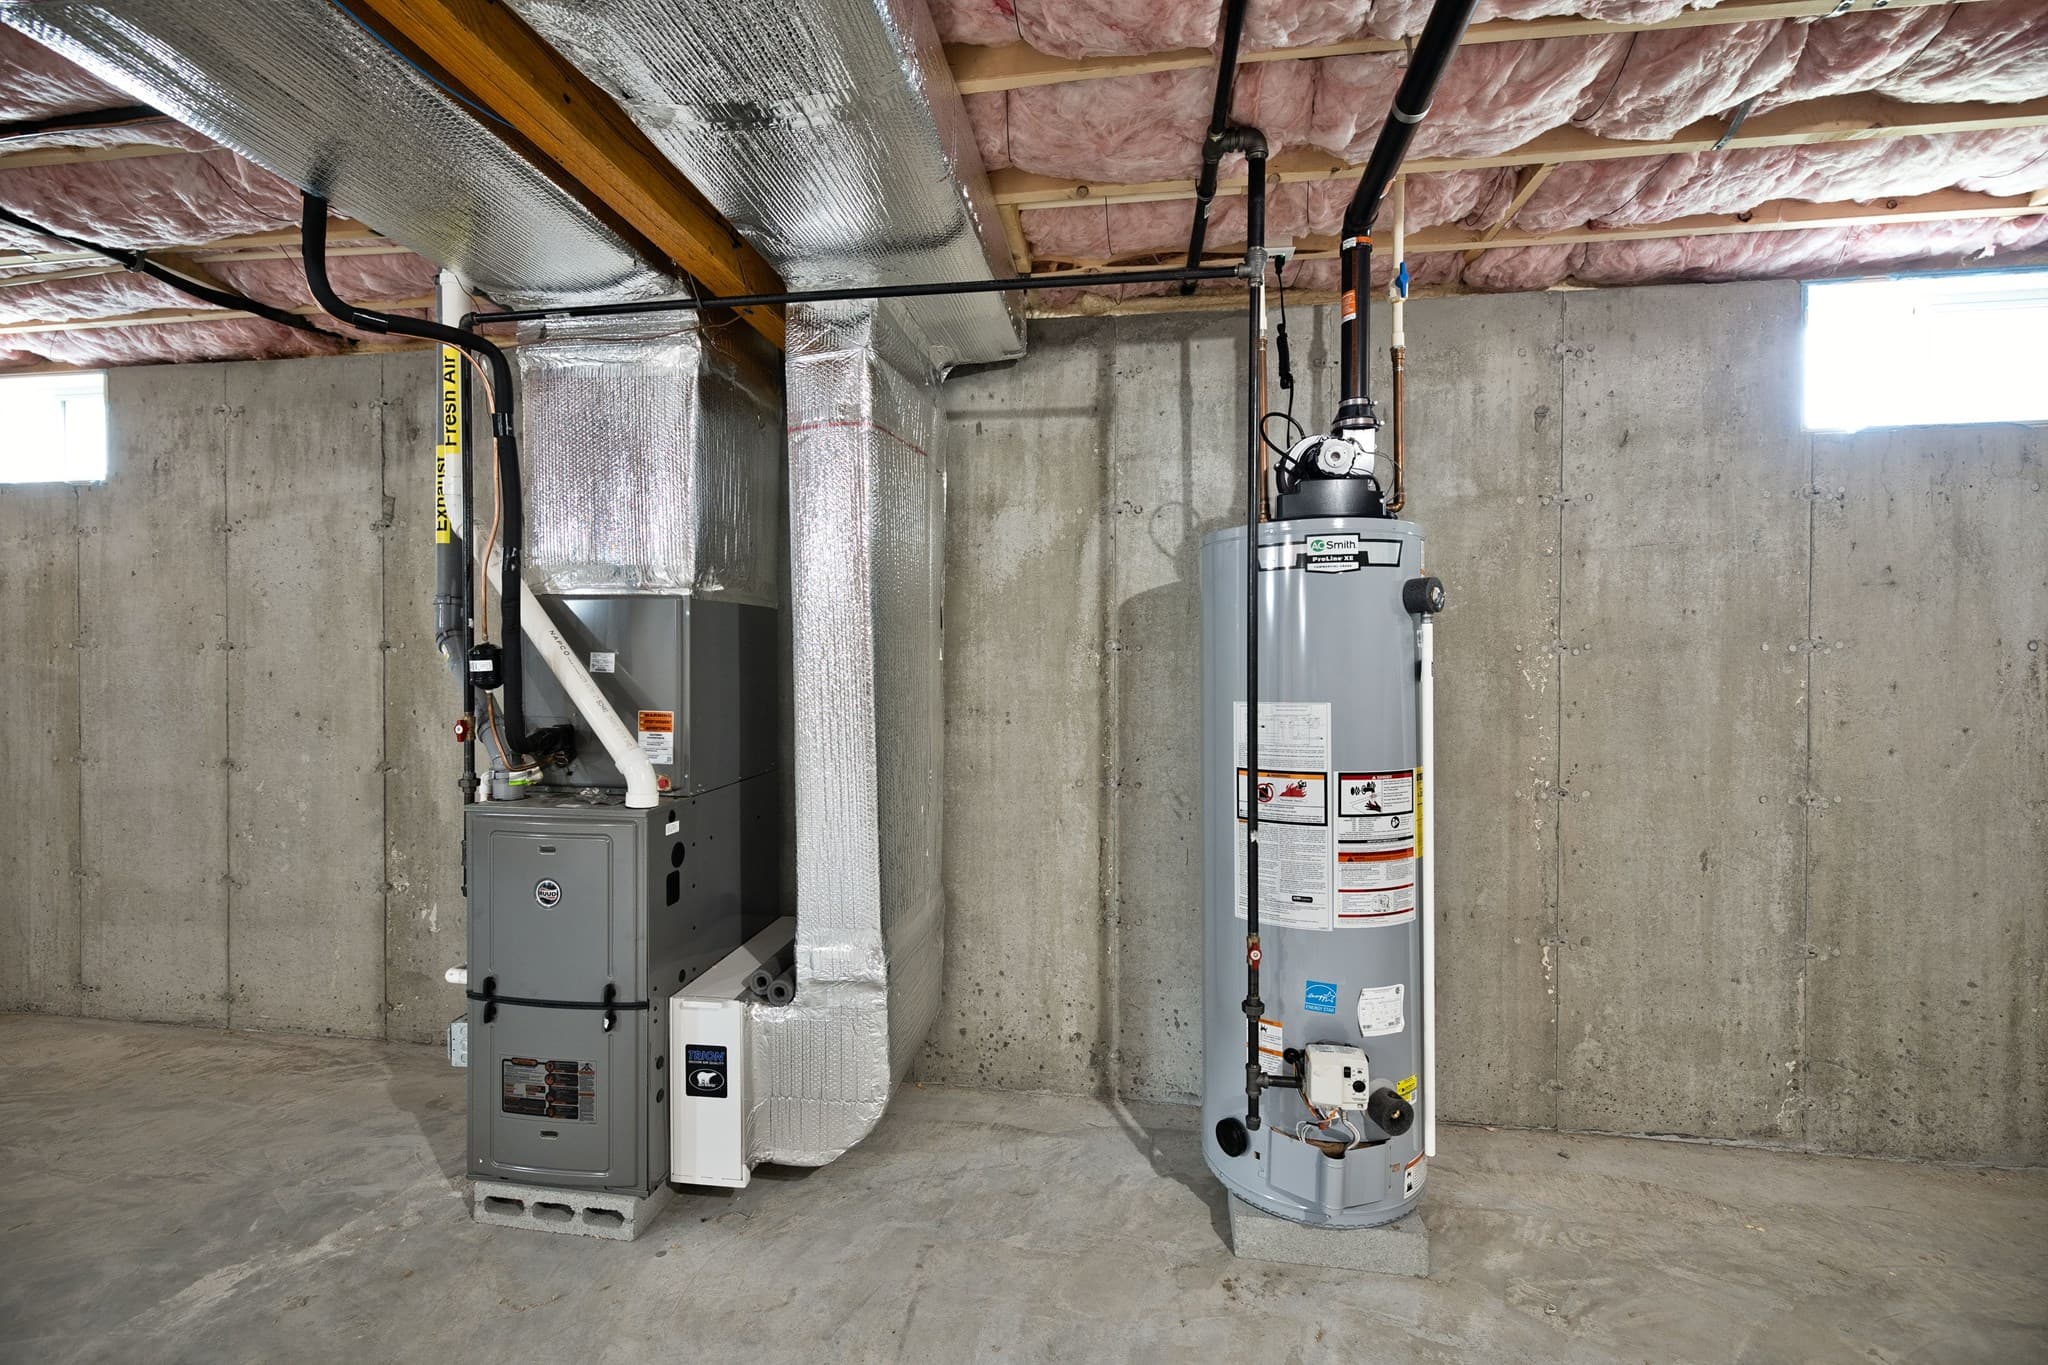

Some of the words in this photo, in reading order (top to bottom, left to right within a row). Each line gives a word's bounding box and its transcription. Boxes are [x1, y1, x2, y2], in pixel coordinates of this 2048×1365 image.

[443, 355, 456, 384] Air
[445, 390, 457, 446] Fresh
[1326, 540, 1356, 550] Smith
[549, 630, 570, 656] NAPCO
[688, 1050, 724, 1061] TRION
